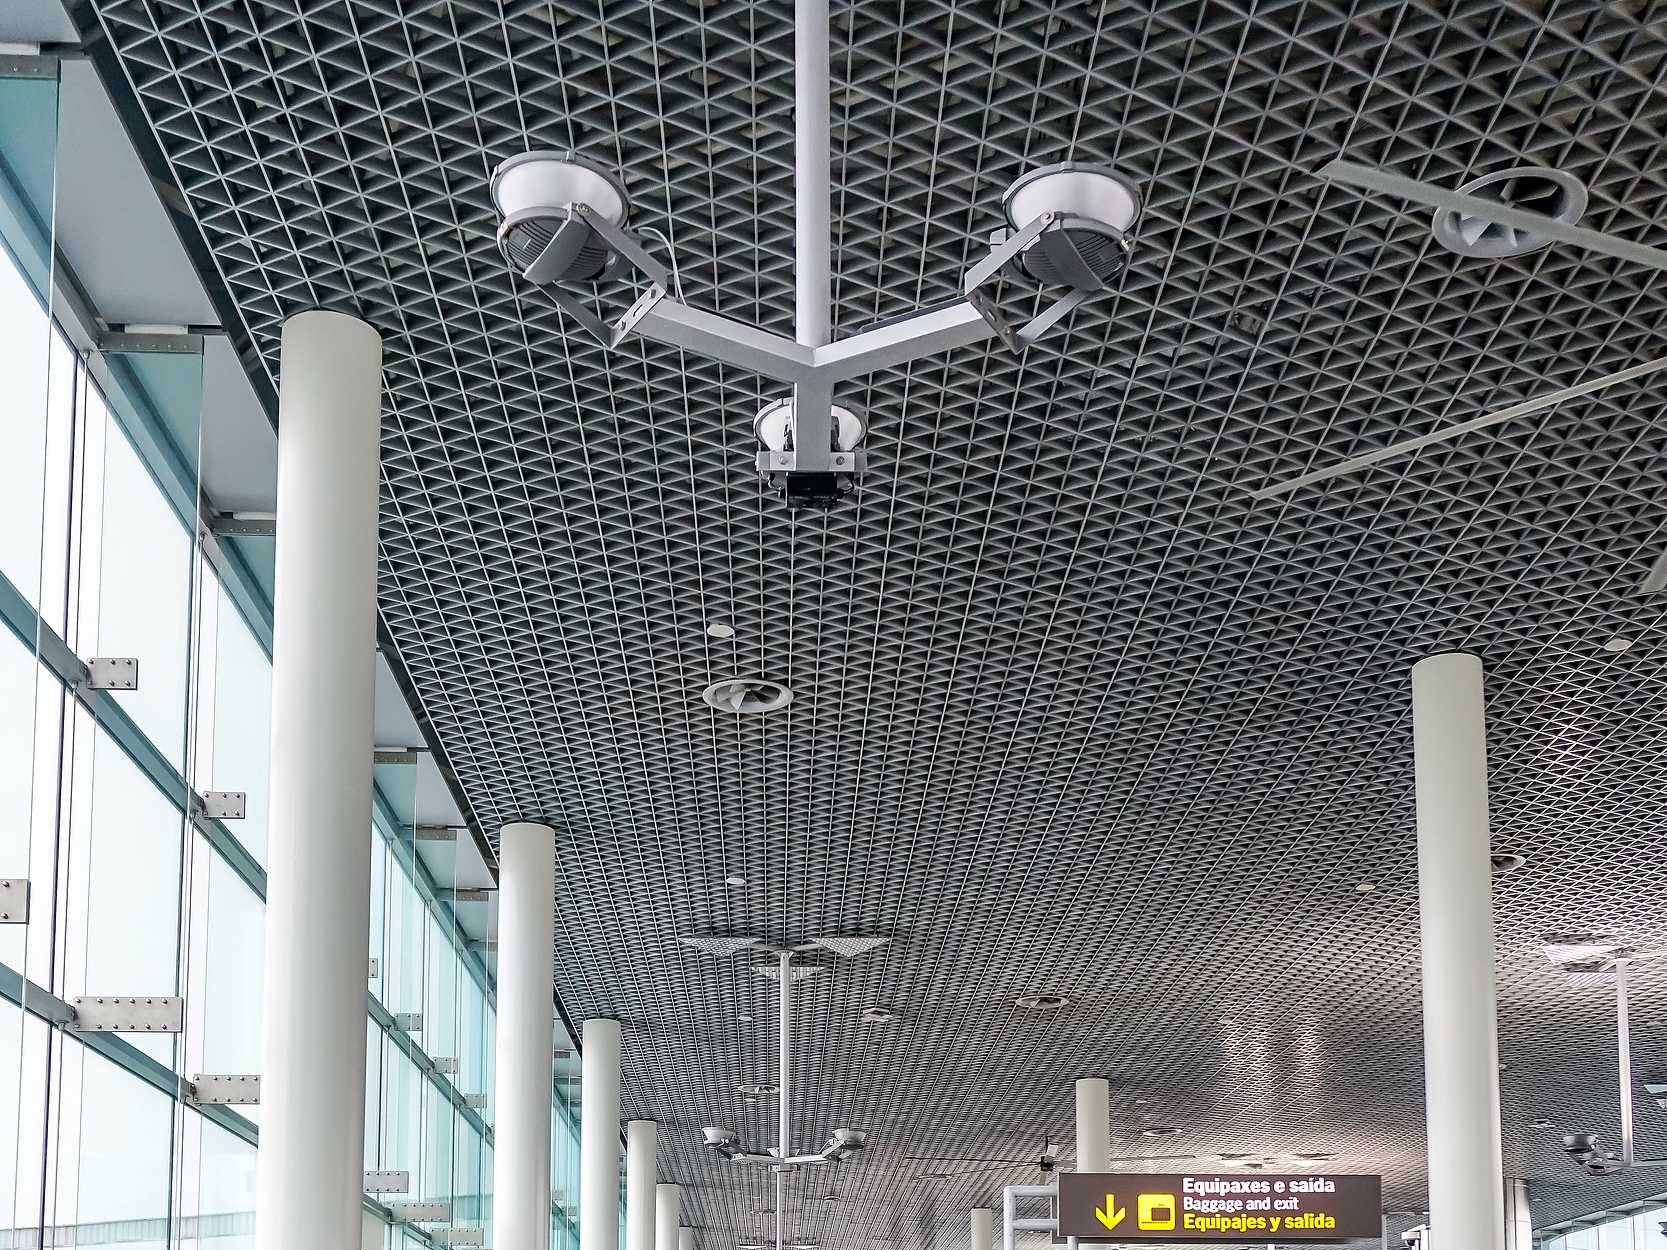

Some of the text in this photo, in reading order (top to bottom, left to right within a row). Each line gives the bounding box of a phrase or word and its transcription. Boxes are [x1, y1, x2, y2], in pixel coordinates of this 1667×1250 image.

[1182, 1177, 1336, 1196] Equipaxes e saída
[1183, 1197, 1299, 1213] Baggage and exit
[1183, 1213, 1336, 1233] Equipajes y salida
